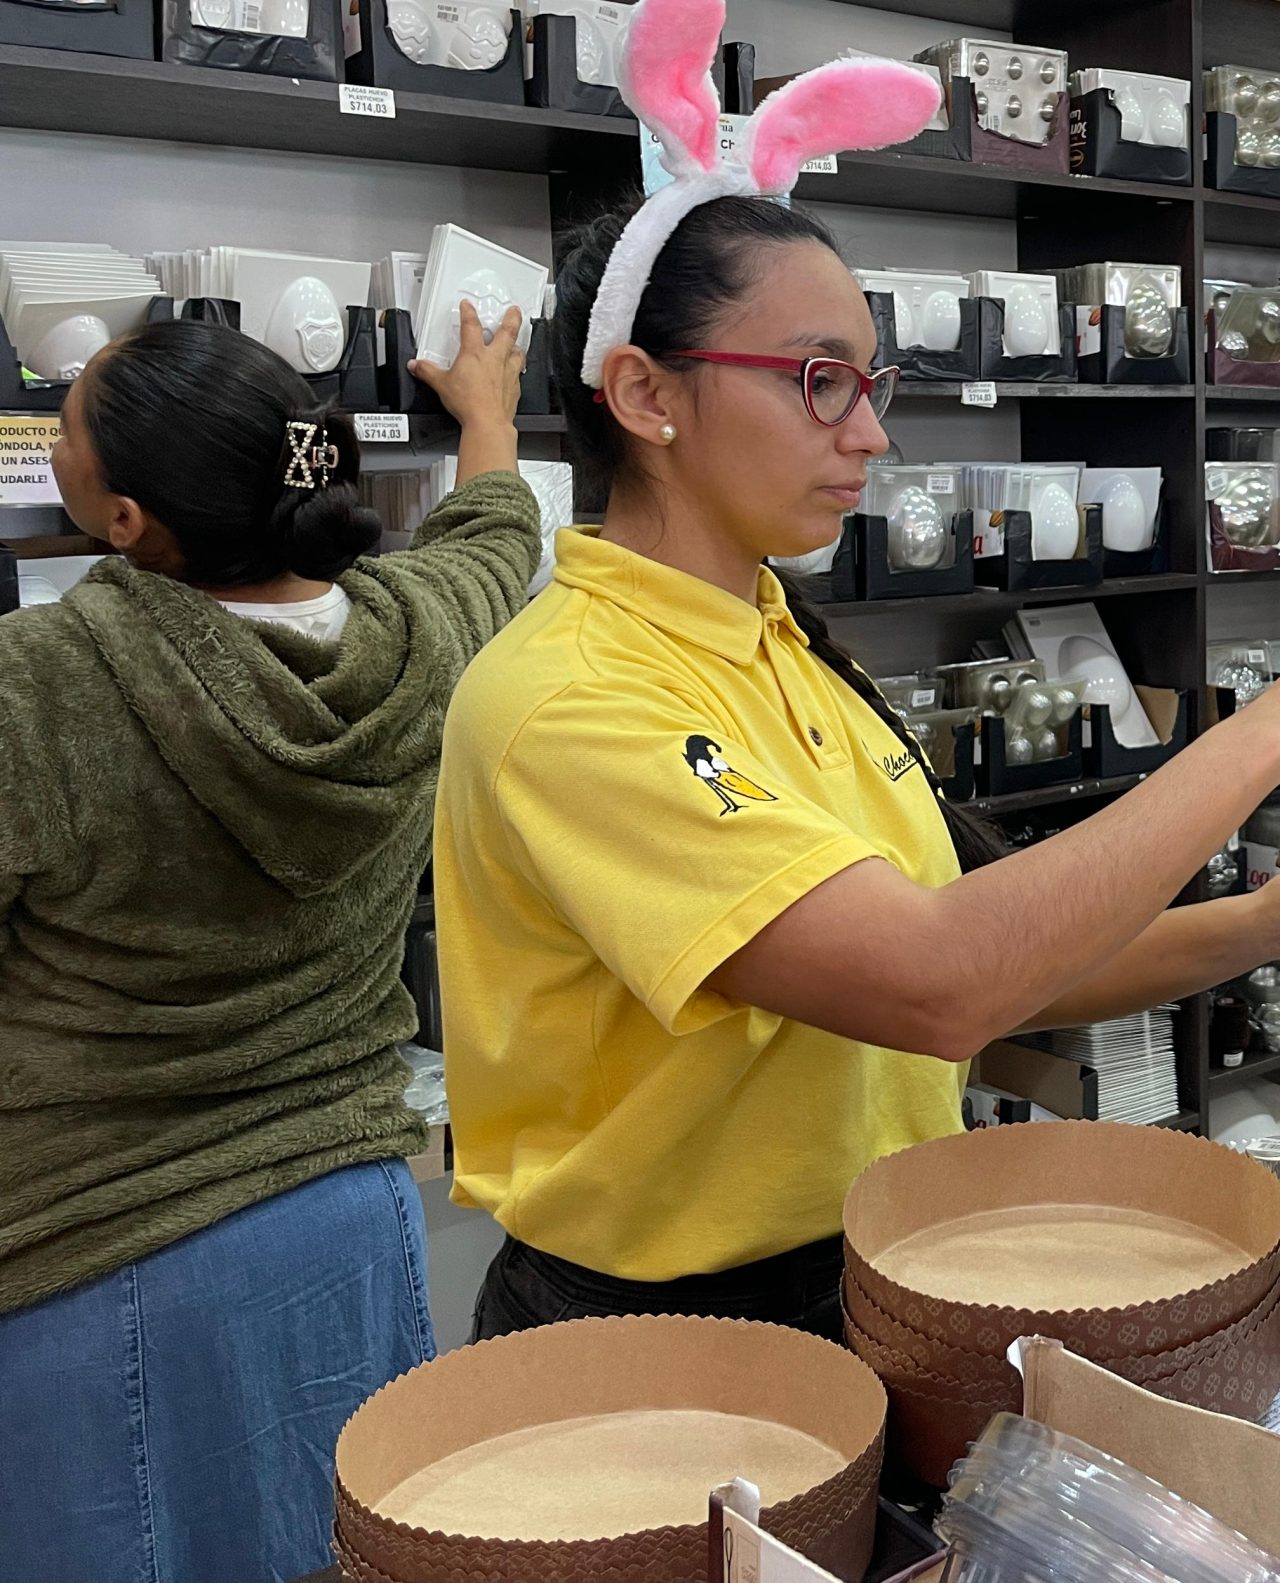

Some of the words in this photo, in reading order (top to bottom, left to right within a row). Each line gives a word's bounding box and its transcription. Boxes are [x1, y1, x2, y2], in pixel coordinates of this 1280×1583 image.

[350, 101, 387, 113] $714,03
[364, 429, 401, 439] $714,03
[2, 457, 17, 465] UN
[20, 457, 51, 465] ASES
[0, 475, 47, 484] UDARLE!
